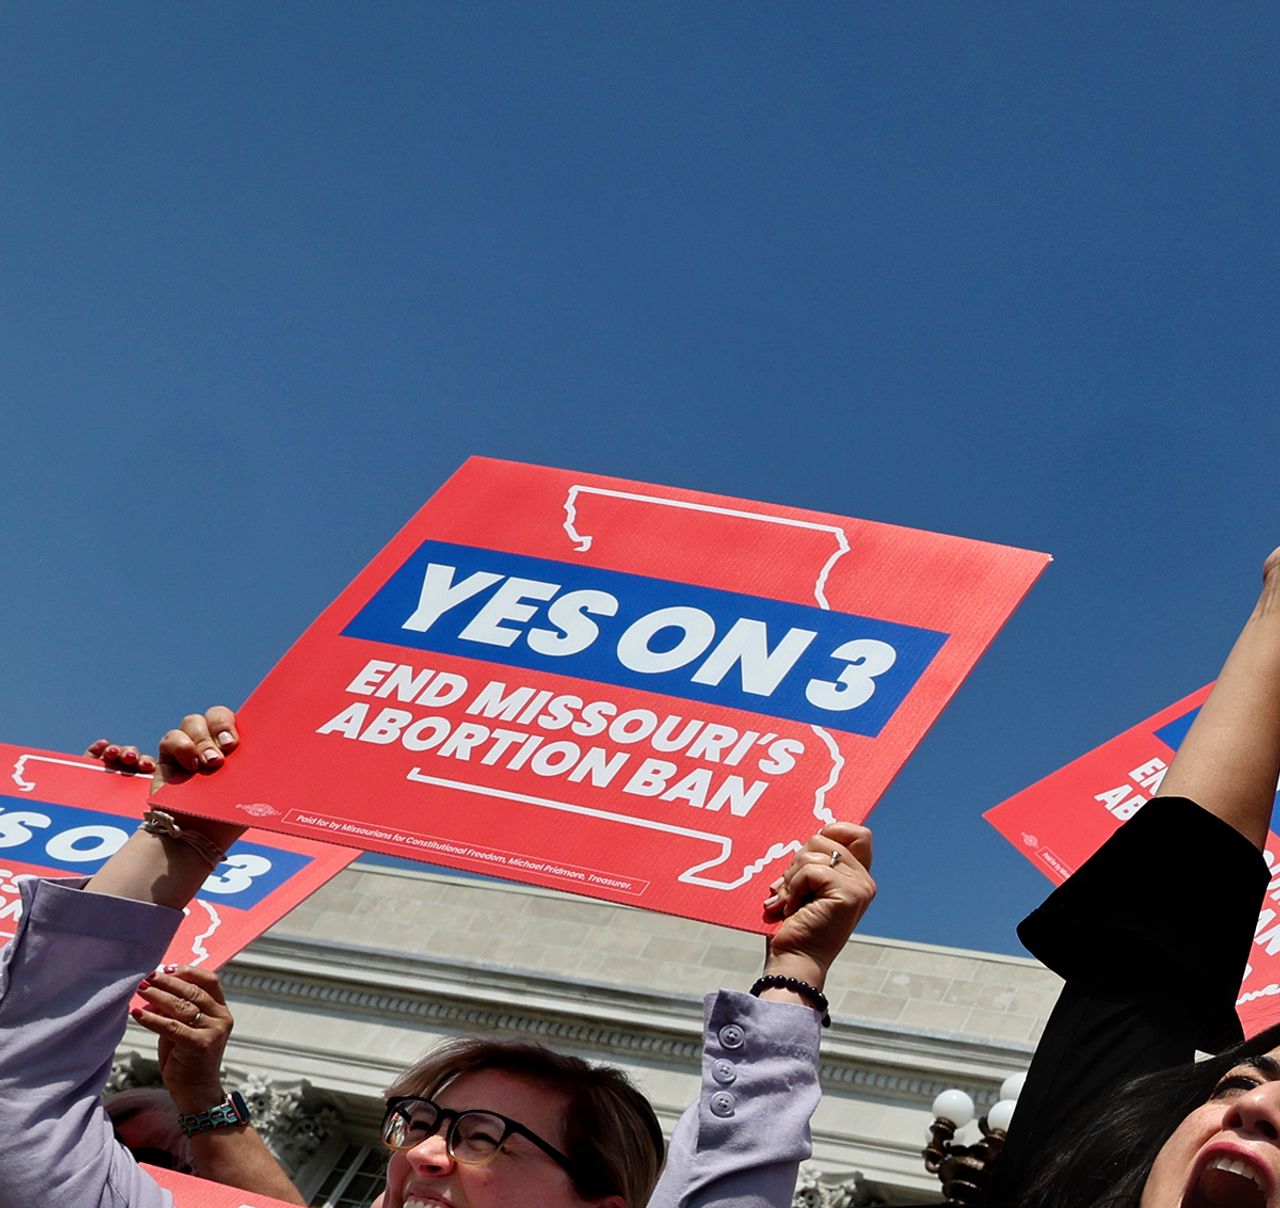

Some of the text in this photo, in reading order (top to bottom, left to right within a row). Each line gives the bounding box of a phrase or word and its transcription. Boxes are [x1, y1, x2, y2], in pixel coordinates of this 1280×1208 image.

[345, 659, 468, 708] END
[401, 563, 897, 711] YES ON 3
[316, 703, 769, 817] ABORTION BAN
[296, 814, 632, 890] Paid for by Missourians for Constitutional Freedom, Michael Pridmore, Treasurer.
